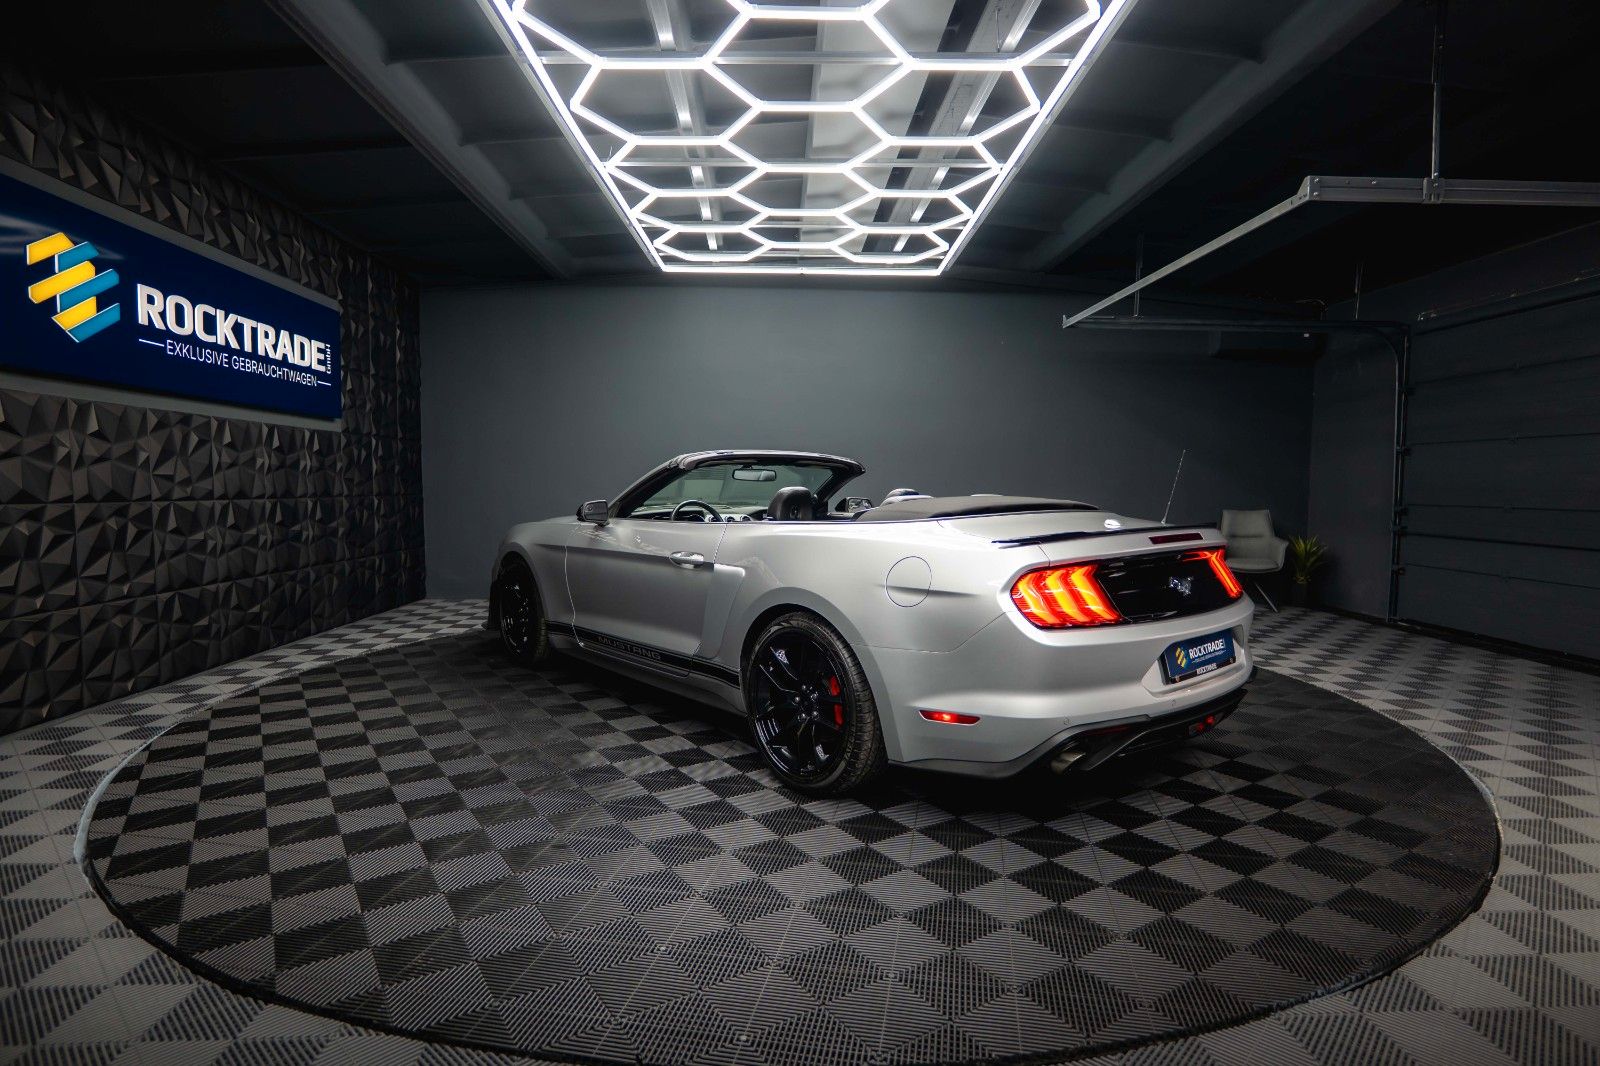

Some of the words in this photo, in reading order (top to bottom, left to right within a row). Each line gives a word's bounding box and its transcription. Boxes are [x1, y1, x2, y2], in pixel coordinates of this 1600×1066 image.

[137, 283, 327, 373] ROCKTRADE
[166, 339, 229, 368] EXKLUSIVE
[231, 355, 317, 387] GEBRAUCHTWAGEN
[598, 636, 661, 660] MUSTANG
[1189, 639, 1224, 659] ROCKTRADE
